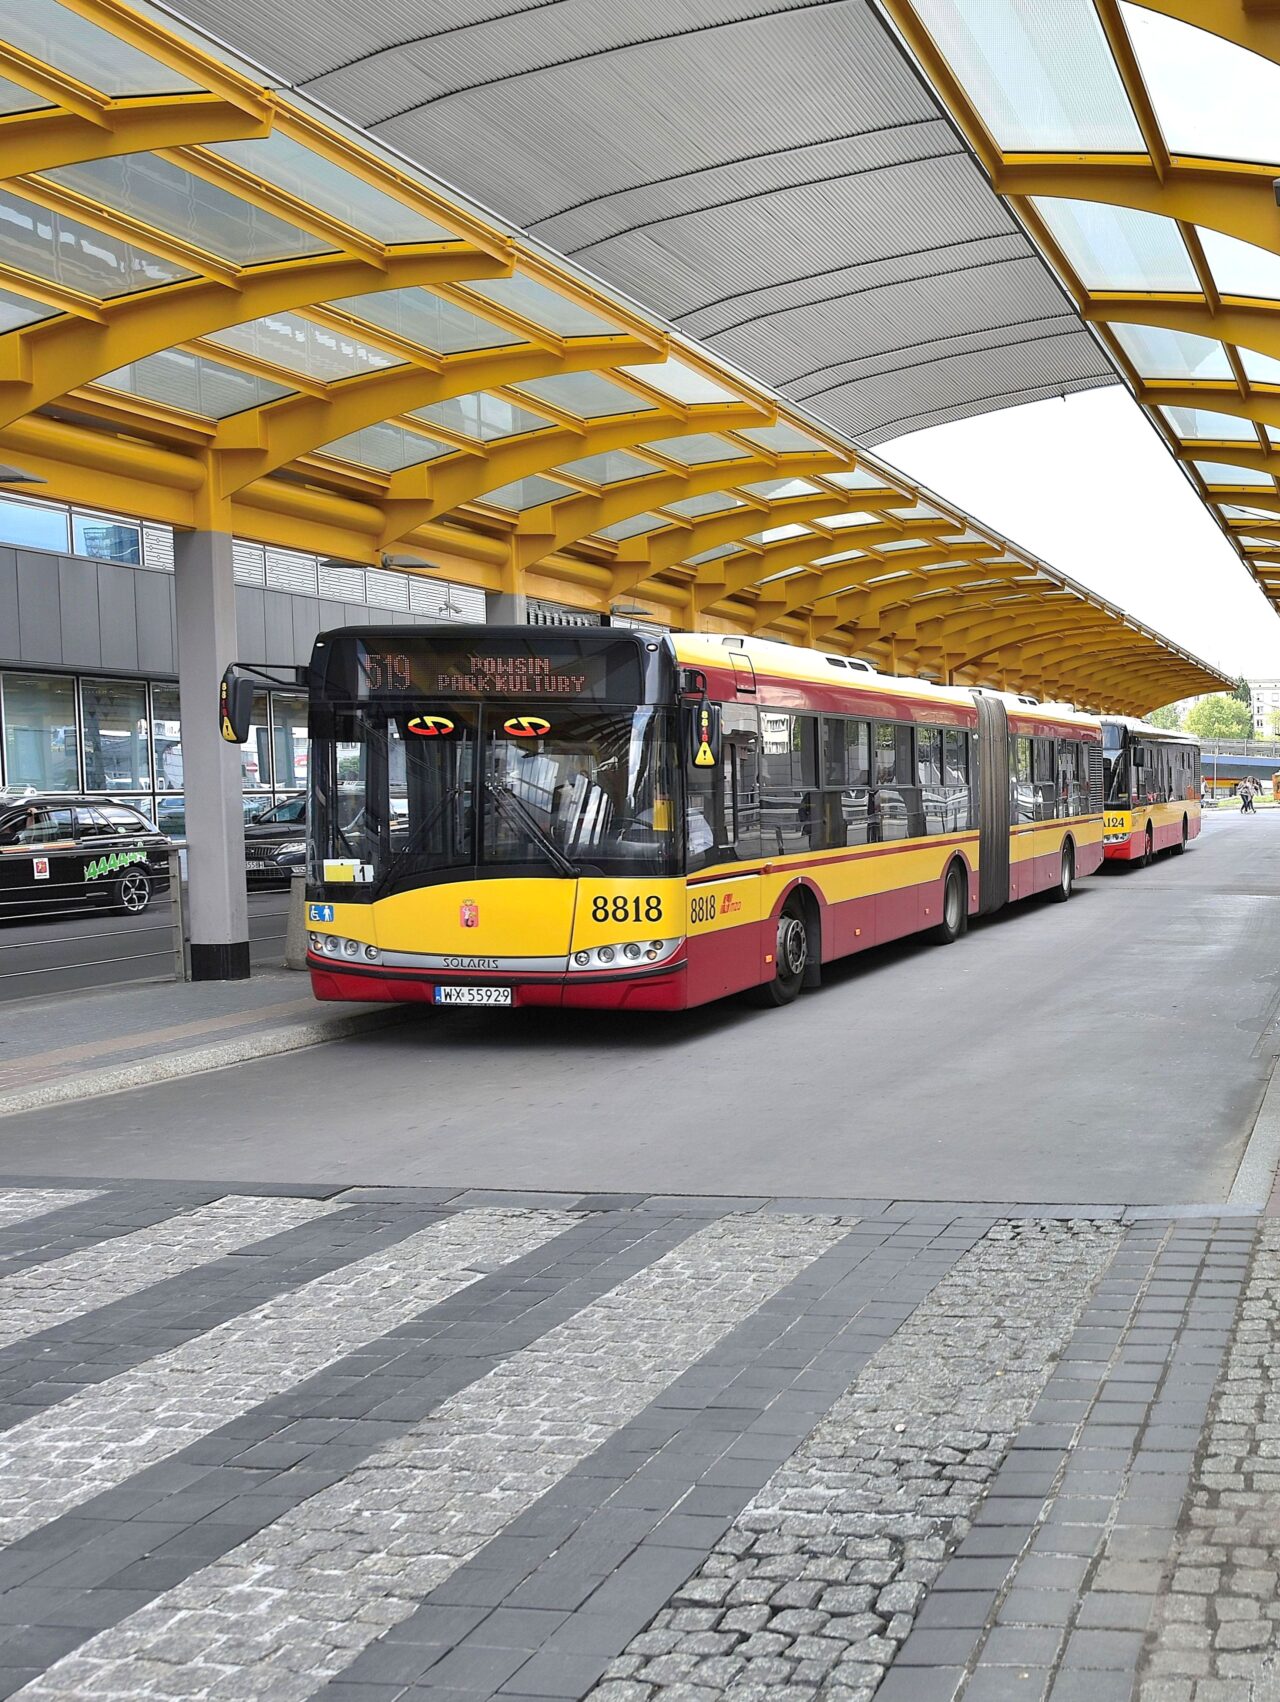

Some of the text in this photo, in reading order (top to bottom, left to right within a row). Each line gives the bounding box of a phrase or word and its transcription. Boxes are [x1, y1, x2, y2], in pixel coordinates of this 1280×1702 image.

[365, 654, 411, 690] 519
[470, 656, 550, 675] POWSIN
[437, 674, 586, 693] PARK KULTURY
[359, 865, 366, 882] 1
[591, 895, 663, 923] 8818
[690, 895, 716, 924] 8818
[442, 957, 499, 969] SOLARIS
[443, 987, 462, 1002] WX
[467, 988, 510, 1003] 55929
